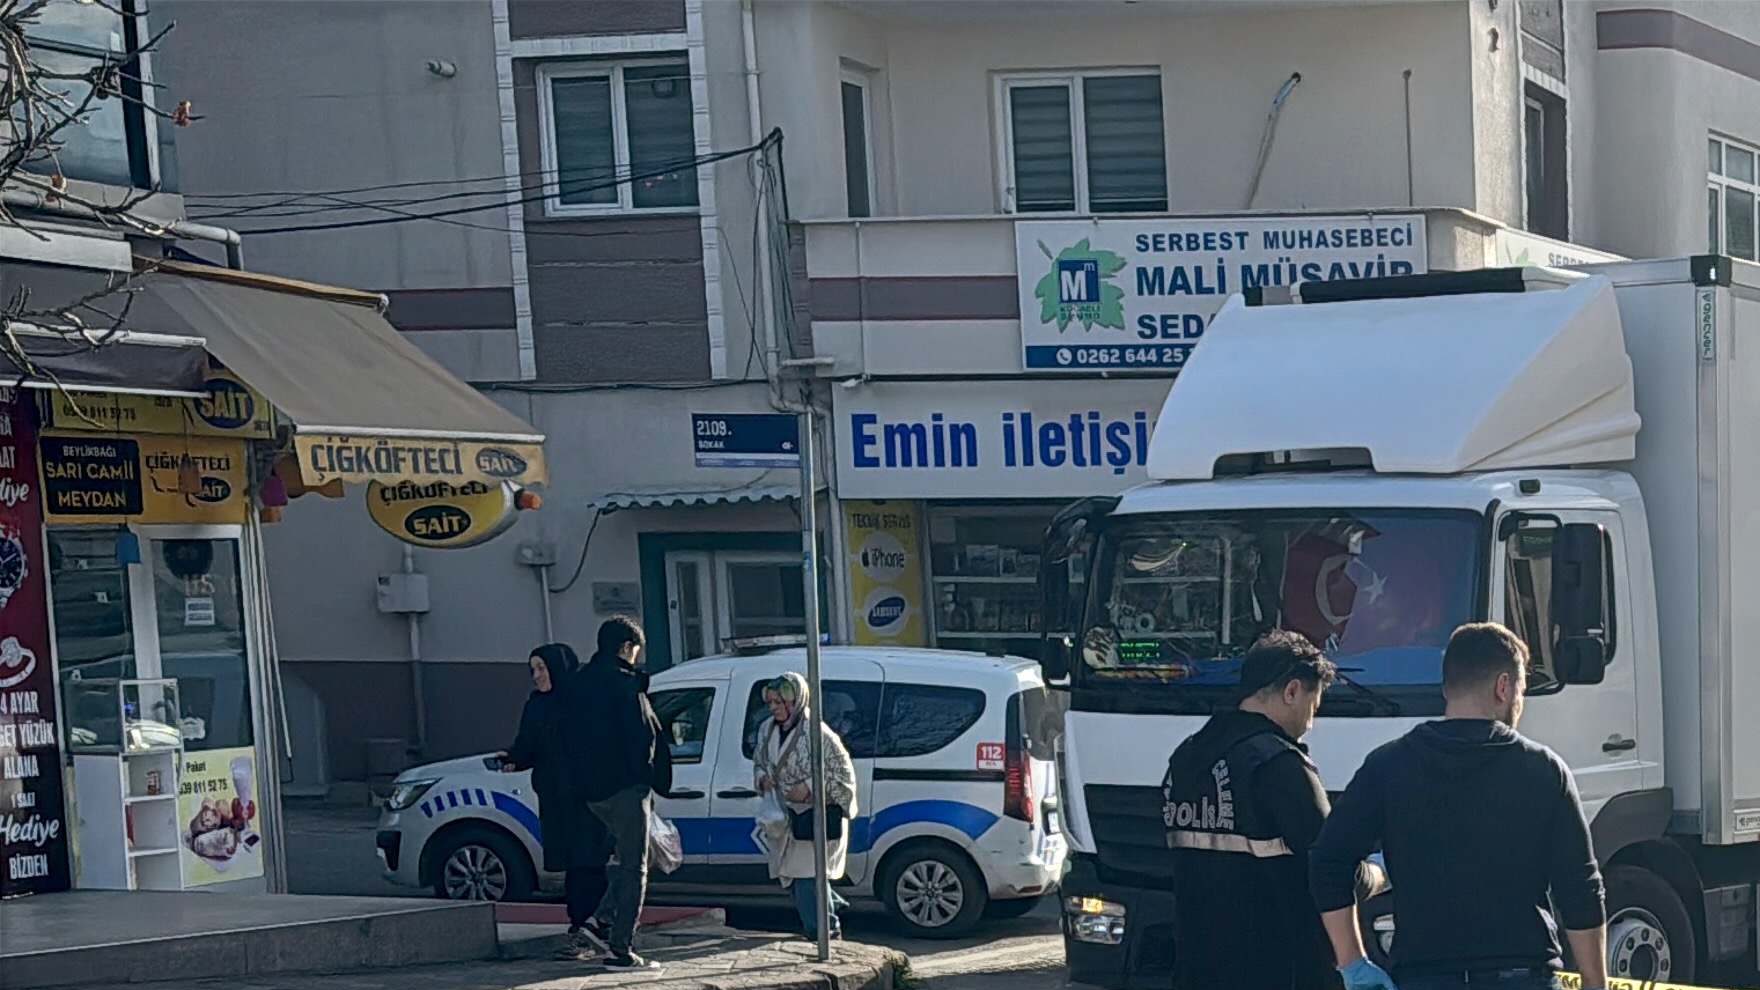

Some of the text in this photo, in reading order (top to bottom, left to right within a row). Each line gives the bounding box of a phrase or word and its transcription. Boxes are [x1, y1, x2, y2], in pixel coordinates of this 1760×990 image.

[1135, 222, 1413, 253] SERBEST MUHASEBECİ
[1137, 257, 1226, 297] MALİ
[1137, 314, 1216, 340] SED
[1077, 349, 1120, 364] 0262
[1125, 348, 1158, 363] 644
[1163, 348, 1184, 363] 25
[696, 420, 732, 436] 2109.
[850, 411, 1156, 475] Emin iletişi
[45, 462, 82, 479] SARI
[311, 436, 463, 481] ÇİĞKÖFTECİ
[58, 490, 127, 508] MEYDAN
[202, 481, 224, 498] AİT
[413, 511, 461, 535] SAİT
[871, 547, 905, 568] iPhone
[10, 691, 39, 716] AYAR
[19, 718, 54, 746] YÜZÜK
[981, 746, 1002, 759] 112
[4, 755, 40, 780] ALANA
[186, 761, 207, 773] Paket
[9, 853, 49, 880] BİZDEN
